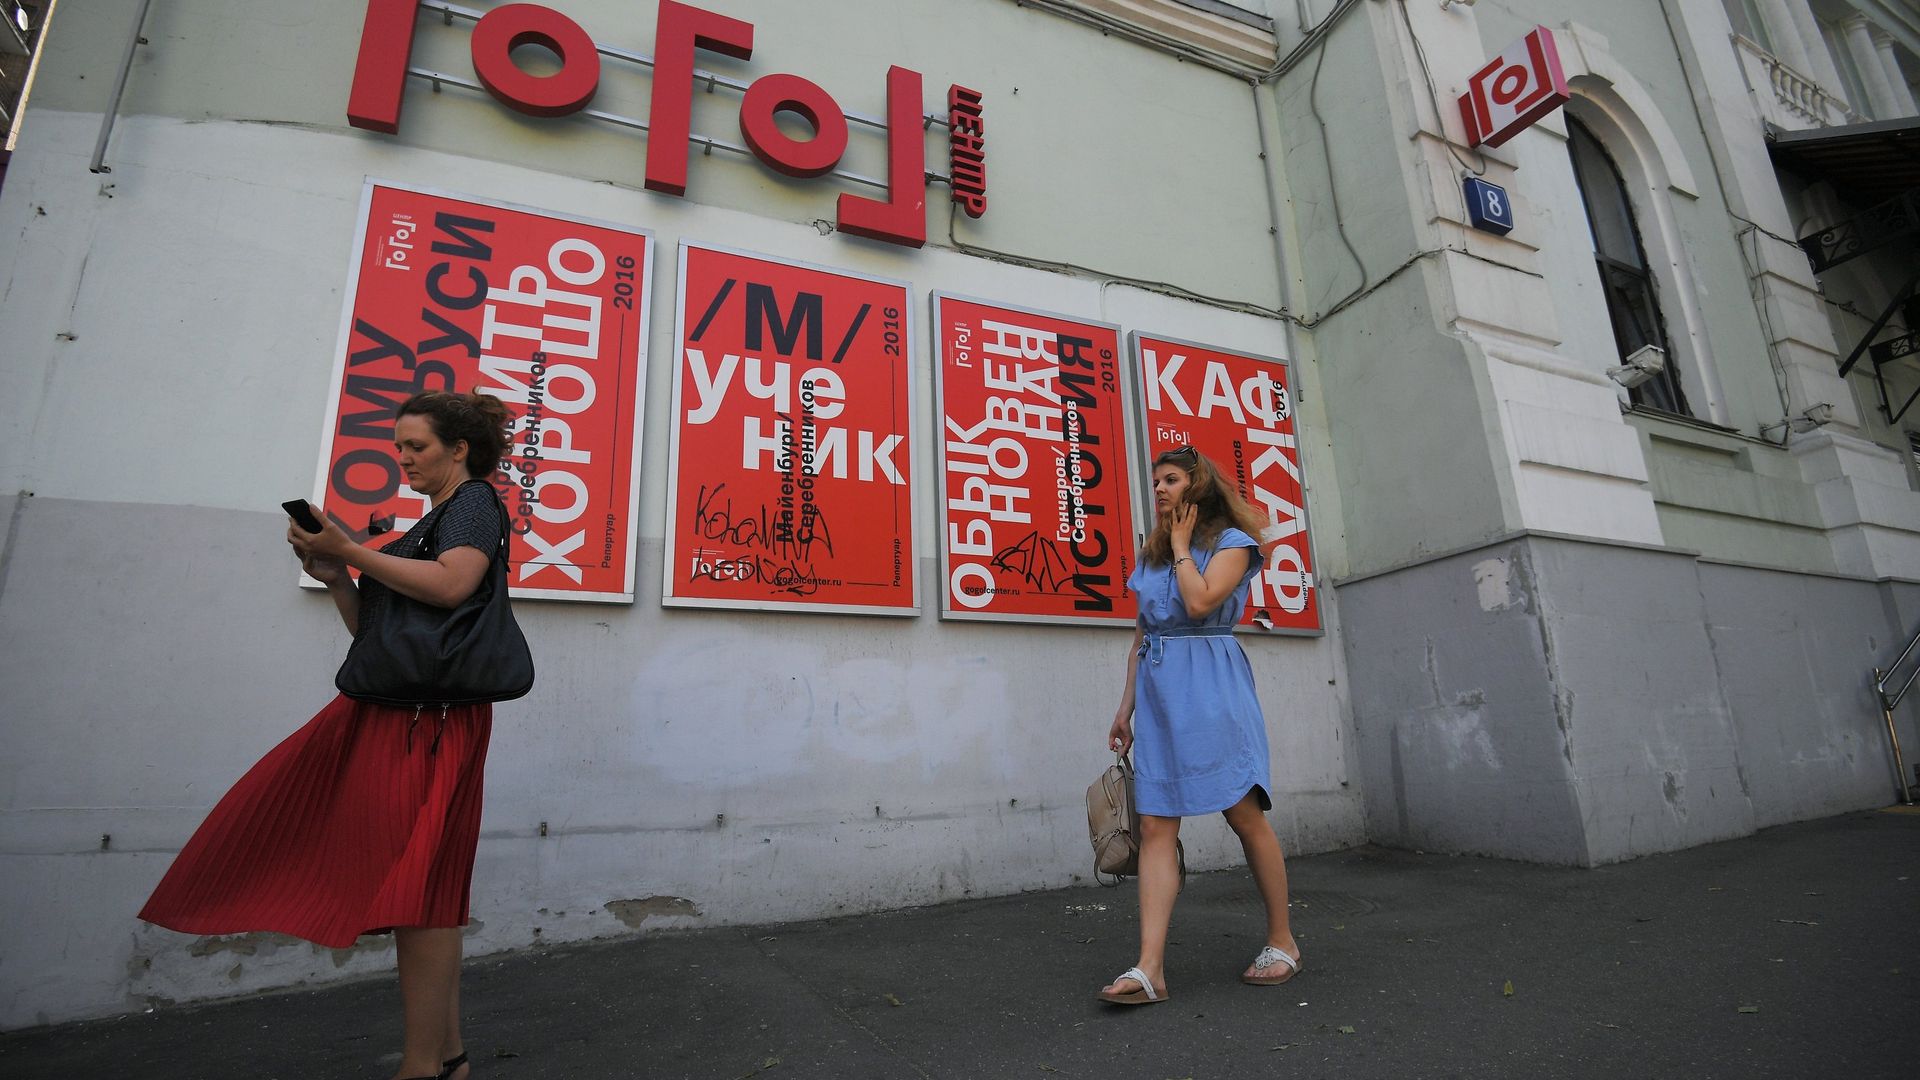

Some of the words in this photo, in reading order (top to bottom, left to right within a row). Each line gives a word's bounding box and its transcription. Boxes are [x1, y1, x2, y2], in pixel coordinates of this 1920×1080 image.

[1486, 190, 1502, 217] 8
[613, 255, 636, 311] 2016
[884, 307, 900, 357] 2016
[685, 348, 847, 425] уче
[1020, 326, 1065, 443] НАЯ
[1101, 348, 1115, 394] 2016
[1143, 349, 1291, 429] КАФ
[1272, 380, 1287, 421] 2016
[510, 351, 548, 536] Серебренников
[519, 238, 606, 586] ХОРОШО
[981, 319, 1032, 525] НОВЕН
[743, 416, 907, 486] ник
[796, 379, 818, 545] Серебренников
[1056, 333, 1113, 612] ИСТОРИЯ
[1066, 400, 1088, 544] Серебренников
[601, 512, 614, 569] Репертуар
[945, 414, 995, 609] ОБЫК
[892, 538, 902, 587] Репертуар
[964, 586, 1020, 596] gogolcenter.ru
[1121, 555, 1129, 600] Репертуар
